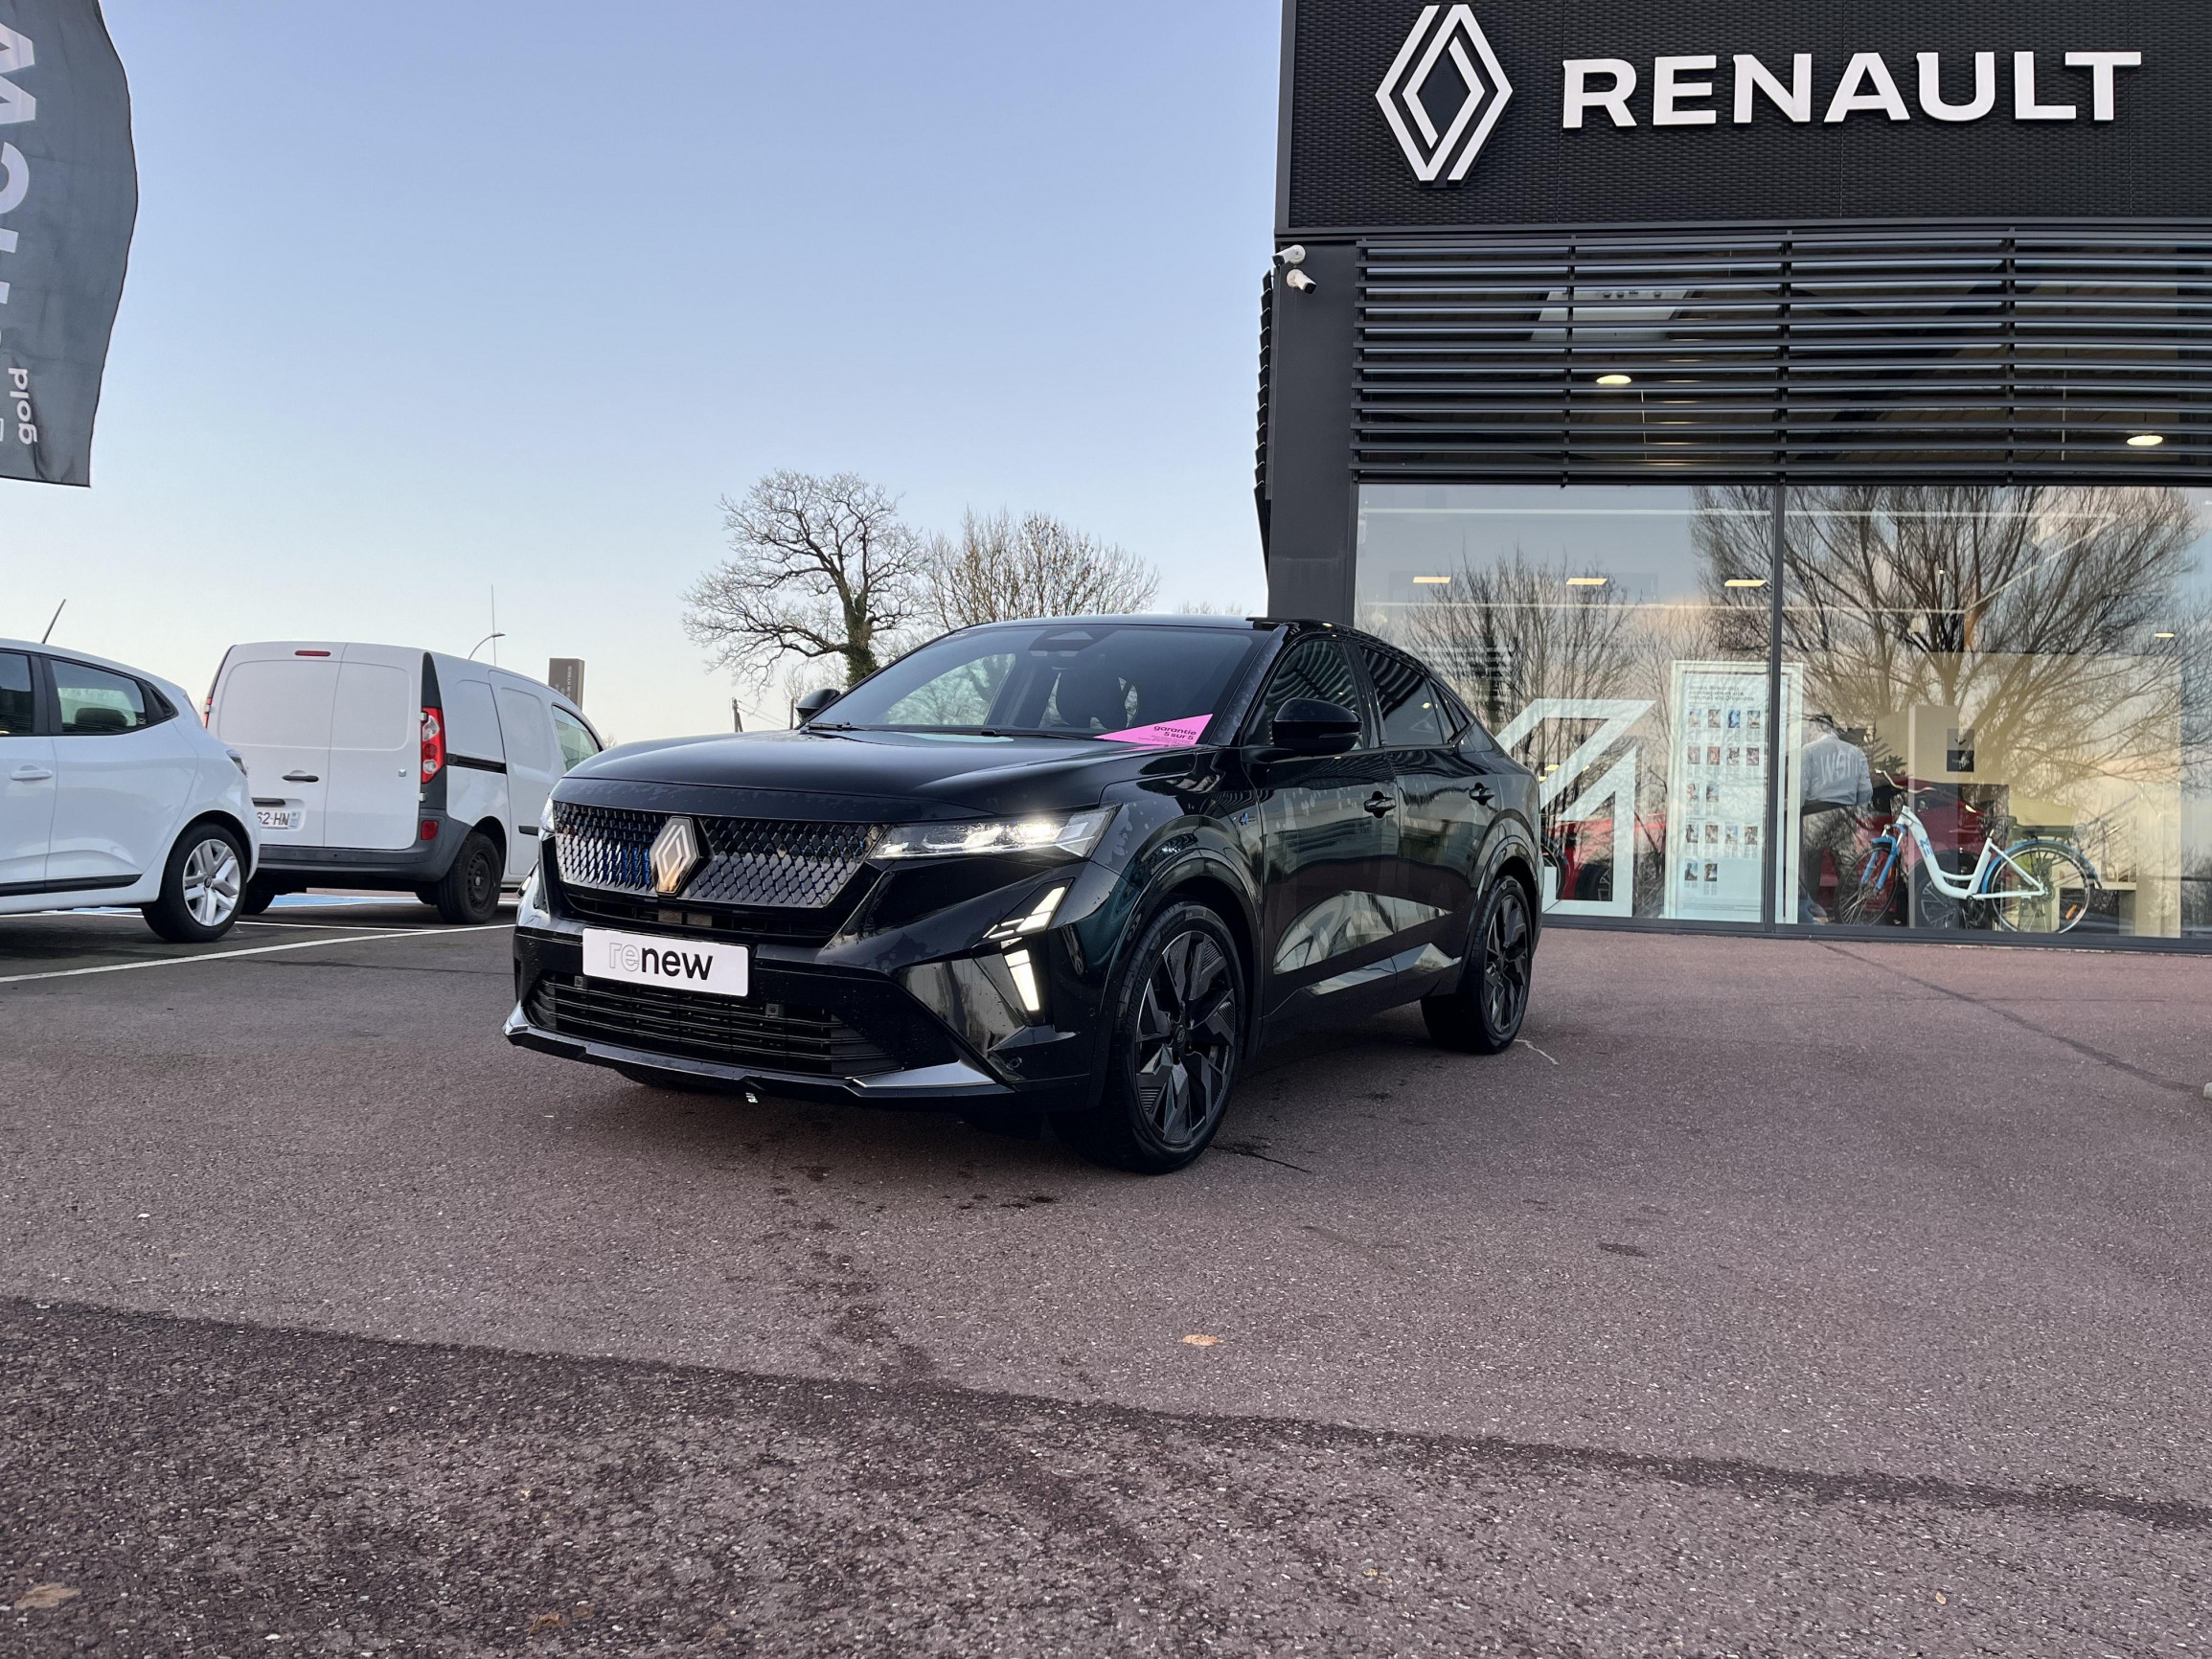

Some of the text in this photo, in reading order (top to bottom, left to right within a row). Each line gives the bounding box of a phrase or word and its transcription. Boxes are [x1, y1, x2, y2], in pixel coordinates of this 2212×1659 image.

[1562, 51, 2142, 129] RENAULT
[8, 368, 37, 444] gold
[1153, 725, 1197, 735] garantie
[609, 943, 713, 980] renew
